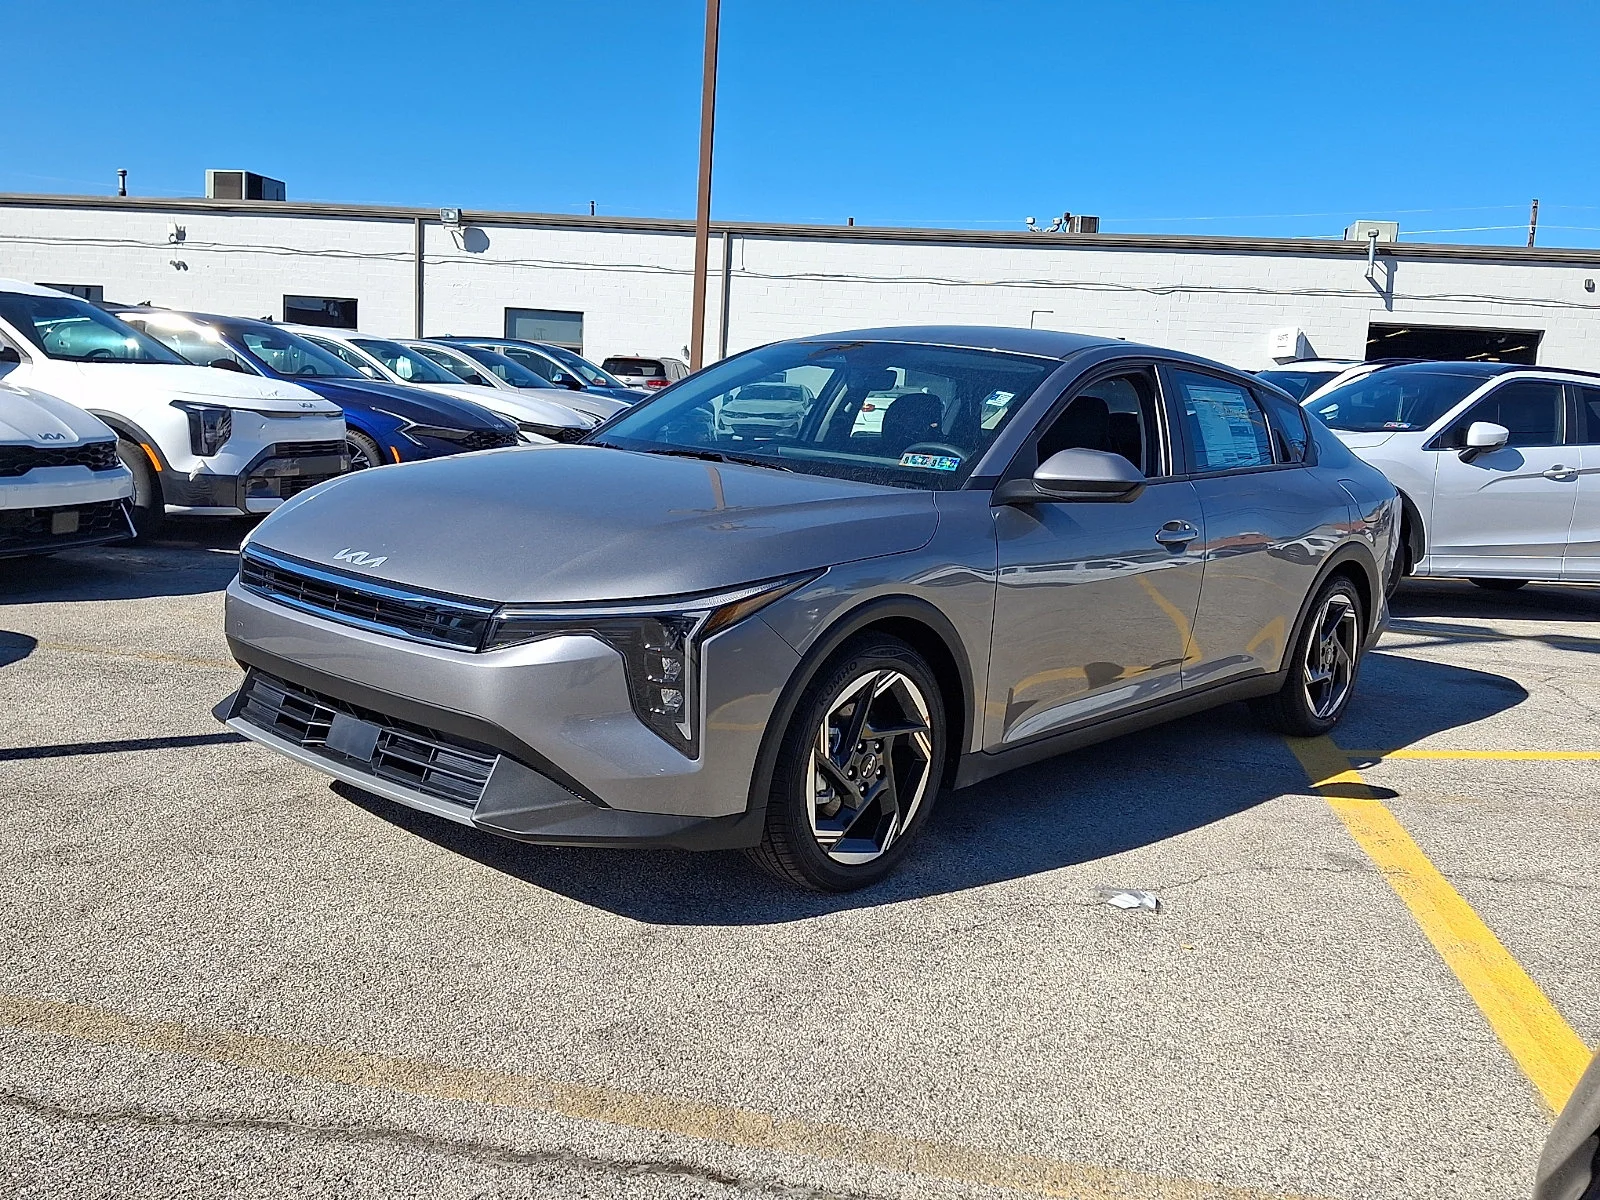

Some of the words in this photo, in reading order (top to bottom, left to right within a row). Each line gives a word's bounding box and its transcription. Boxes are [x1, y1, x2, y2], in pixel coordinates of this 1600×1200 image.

[37, 432, 66, 440] KIA
[332, 547, 389, 569] KIA
[819, 661, 858, 706] KUMHO
